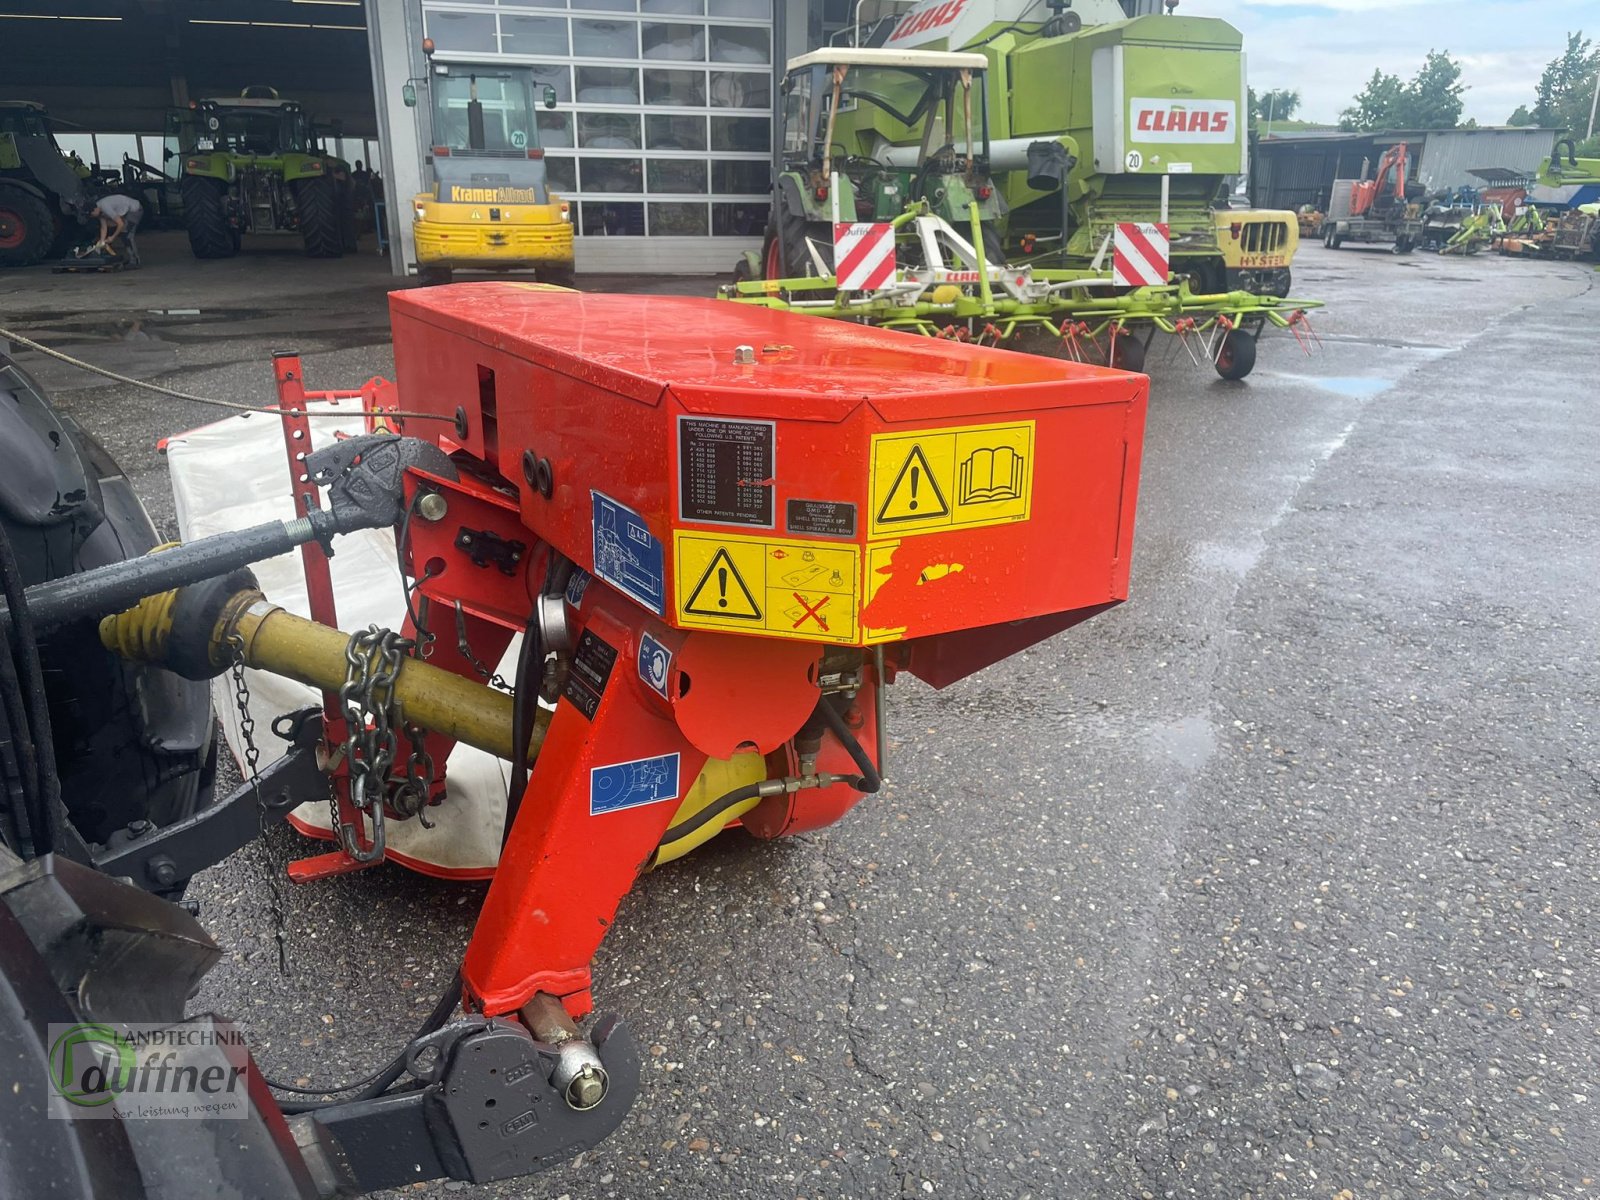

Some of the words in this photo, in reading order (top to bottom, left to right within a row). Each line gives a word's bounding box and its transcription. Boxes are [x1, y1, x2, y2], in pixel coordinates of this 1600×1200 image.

[889, 0, 968, 41] CLAAS
[1137, 110, 1229, 132] CLAAS
[514, 134, 524, 144] 20
[1129, 154, 1140, 168] 20
[1240, 256, 1285, 268] HYSTER
[946, 272, 981, 282] CLAA
